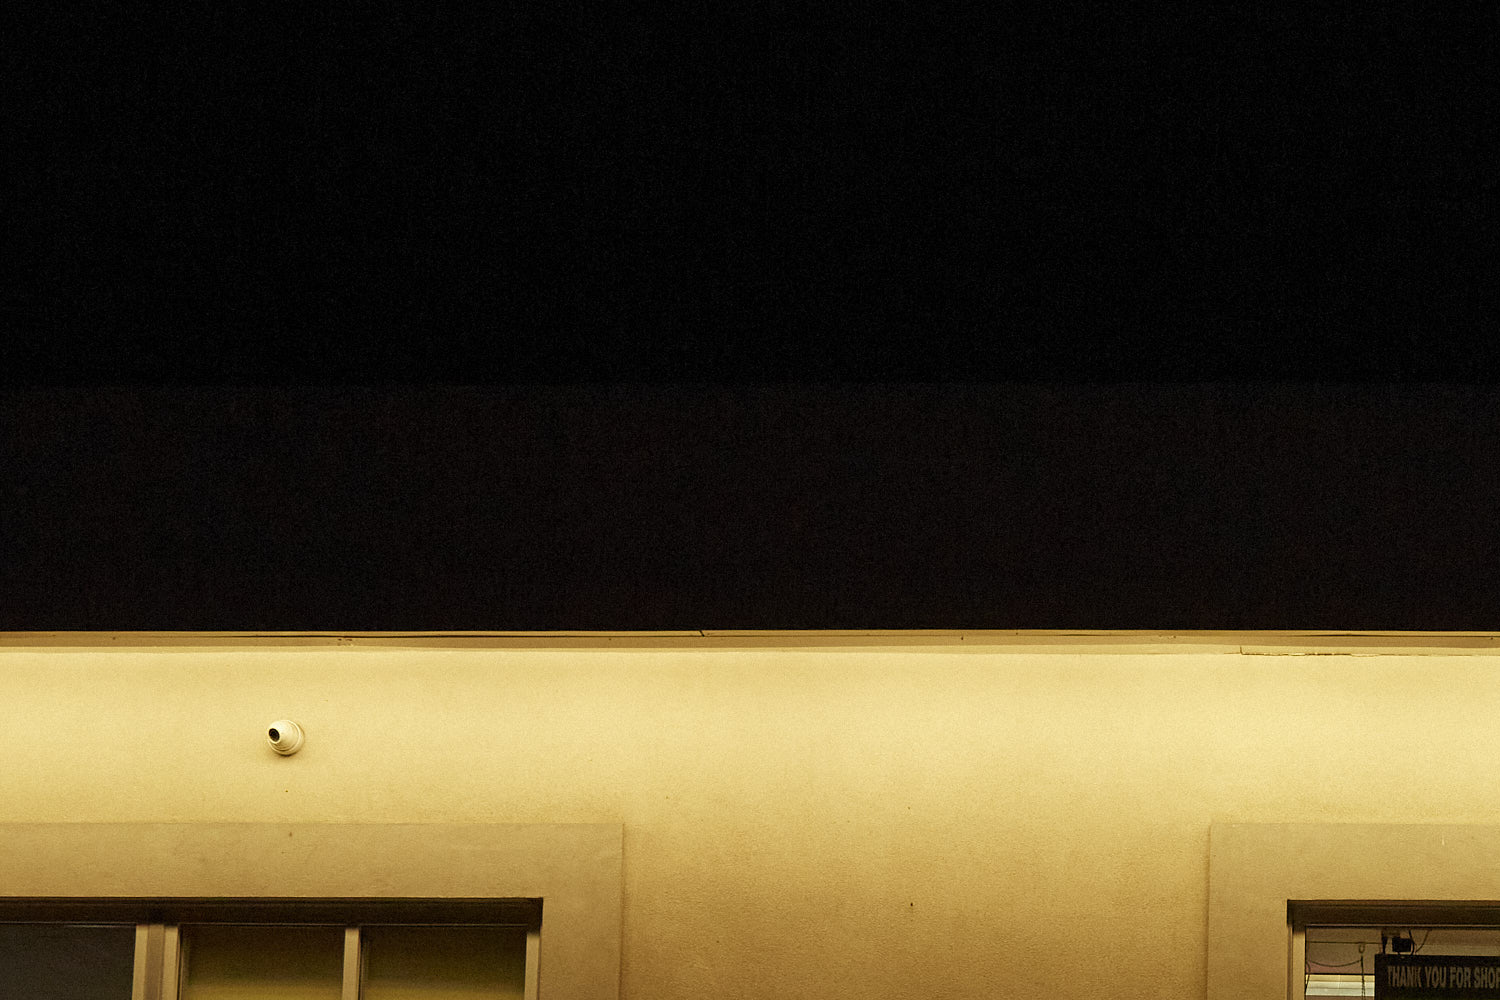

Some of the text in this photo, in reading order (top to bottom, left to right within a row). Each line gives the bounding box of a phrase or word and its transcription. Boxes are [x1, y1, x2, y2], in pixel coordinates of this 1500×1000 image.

[1387, 966, 1420, 988] THANK
[1425, 966, 1449, 988] YOU
[1451, 966, 1470, 988] FOR
